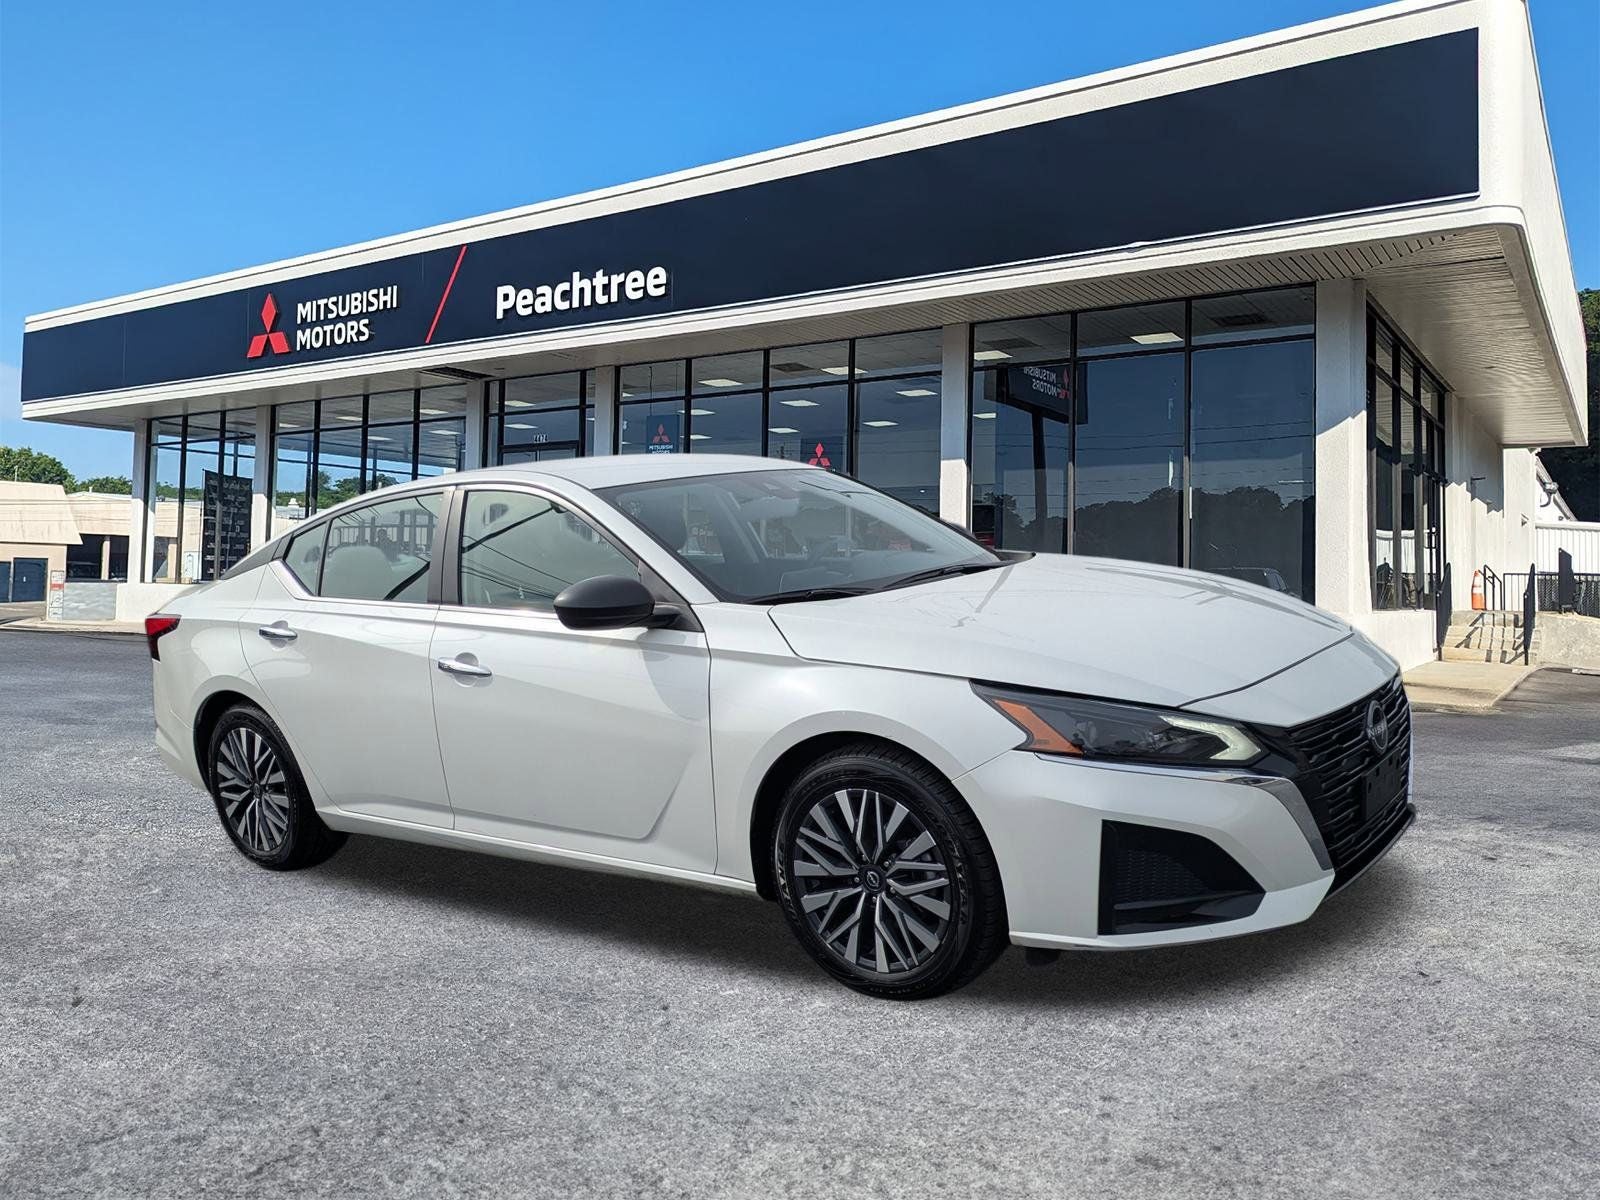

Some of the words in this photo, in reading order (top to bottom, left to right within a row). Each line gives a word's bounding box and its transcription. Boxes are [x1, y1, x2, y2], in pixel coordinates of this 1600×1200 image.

[296, 285, 398, 325] MITSUBISHI
[496, 265, 667, 320] Peachtree
[296, 318, 371, 352] MOTORS
